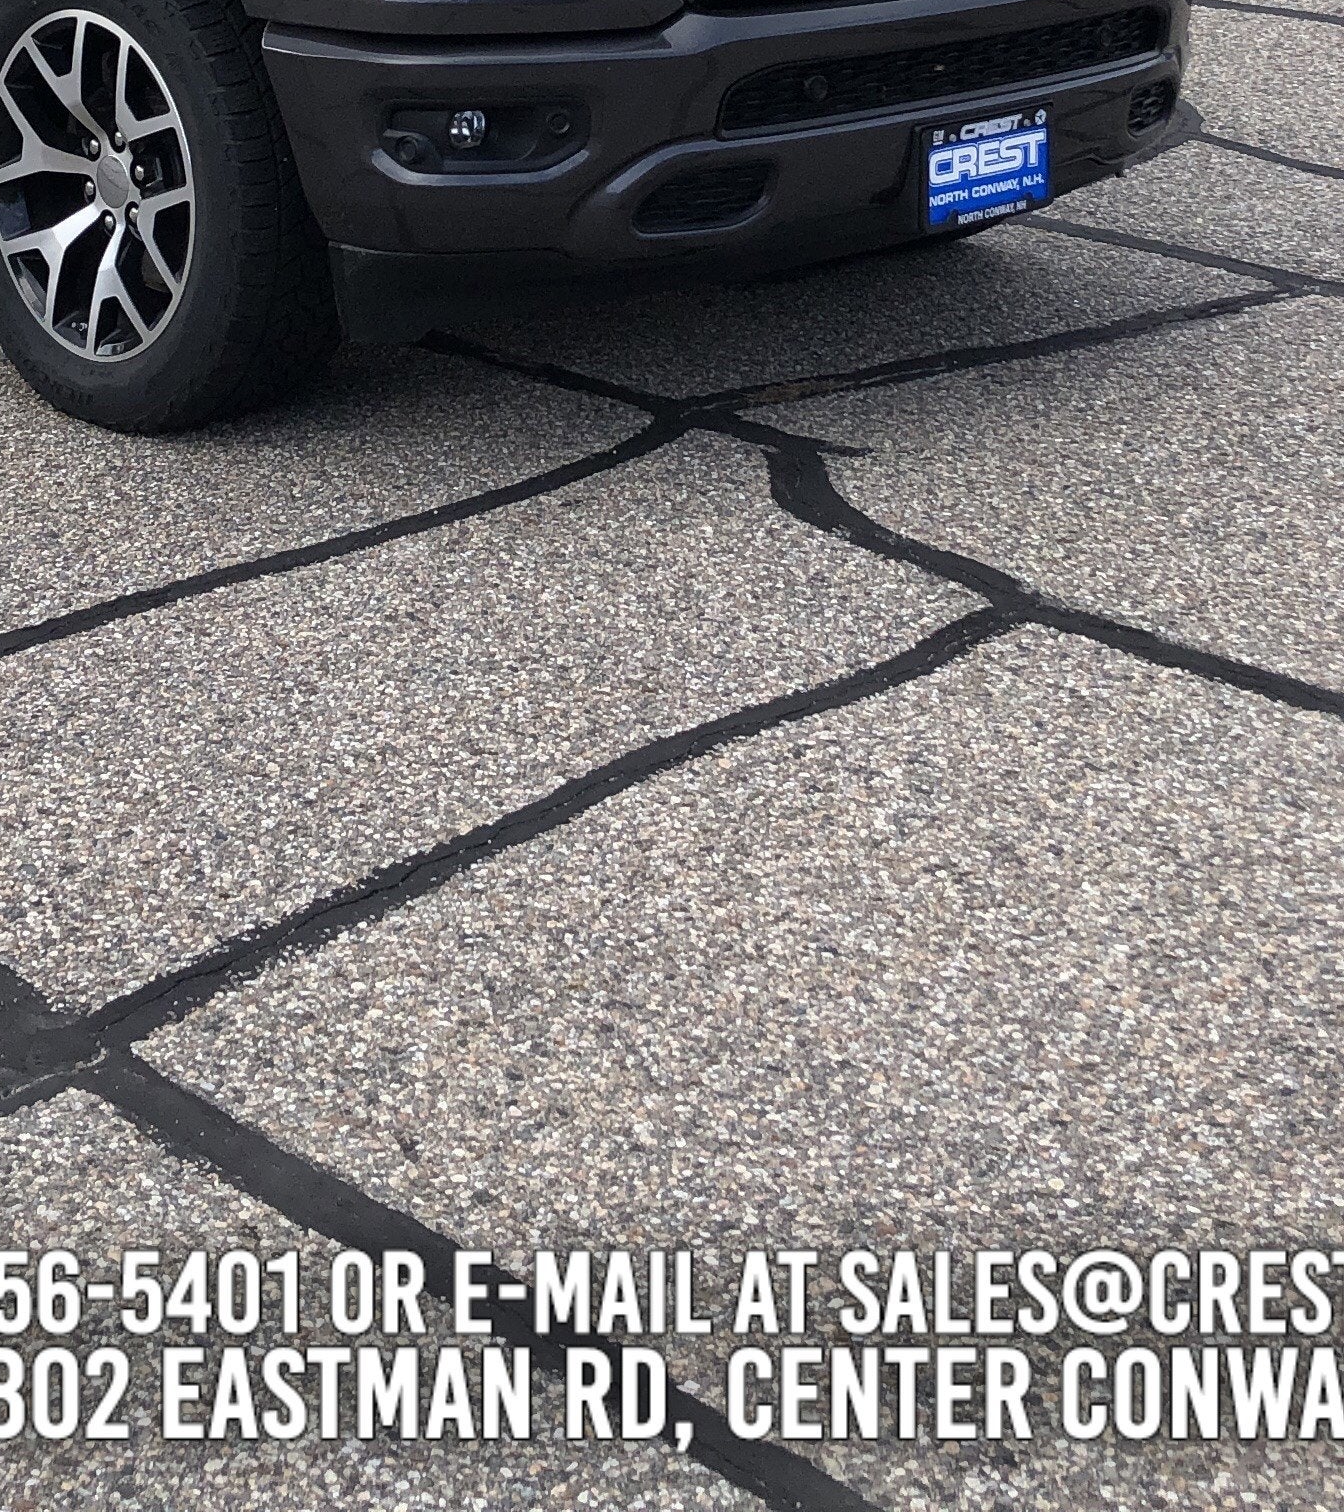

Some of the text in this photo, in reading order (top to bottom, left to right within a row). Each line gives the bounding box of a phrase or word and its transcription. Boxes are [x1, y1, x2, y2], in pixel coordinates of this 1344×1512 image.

[928, 128, 1047, 188] CREST
[929, 173, 1045, 207] NORTH CONWAY, N.H.
[957, 210, 984, 225] NORTH
